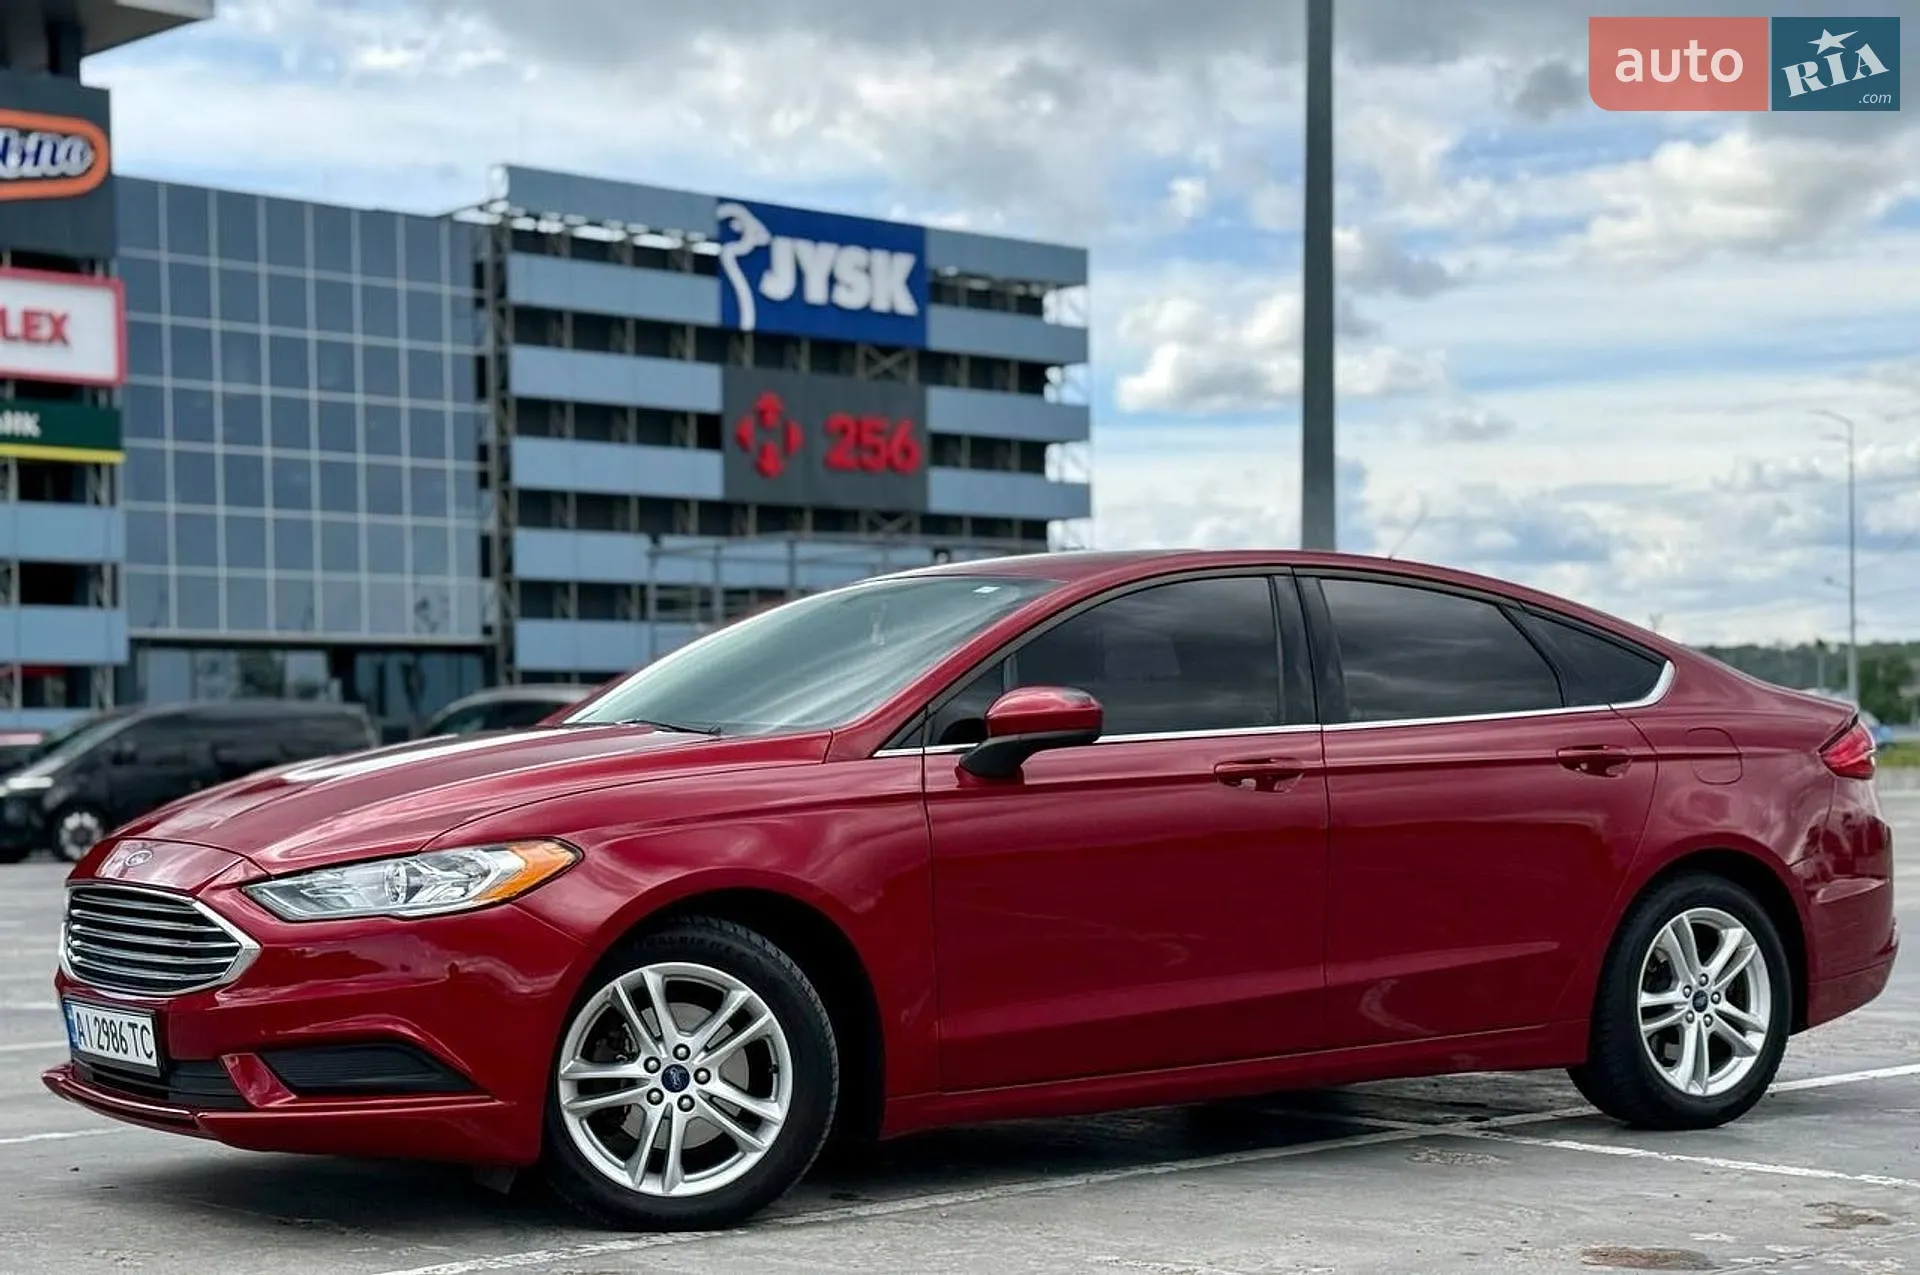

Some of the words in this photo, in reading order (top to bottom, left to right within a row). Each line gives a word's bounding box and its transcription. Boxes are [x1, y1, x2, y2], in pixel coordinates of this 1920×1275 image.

[759, 235, 918, 317] JYSK
[0, 306, 70, 346] LEX
[824, 412, 921, 473] 256
[76, 1011, 95, 1049] AI
[94, 1016, 128, 1055] 2986
[127, 1021, 154, 1059] TC
